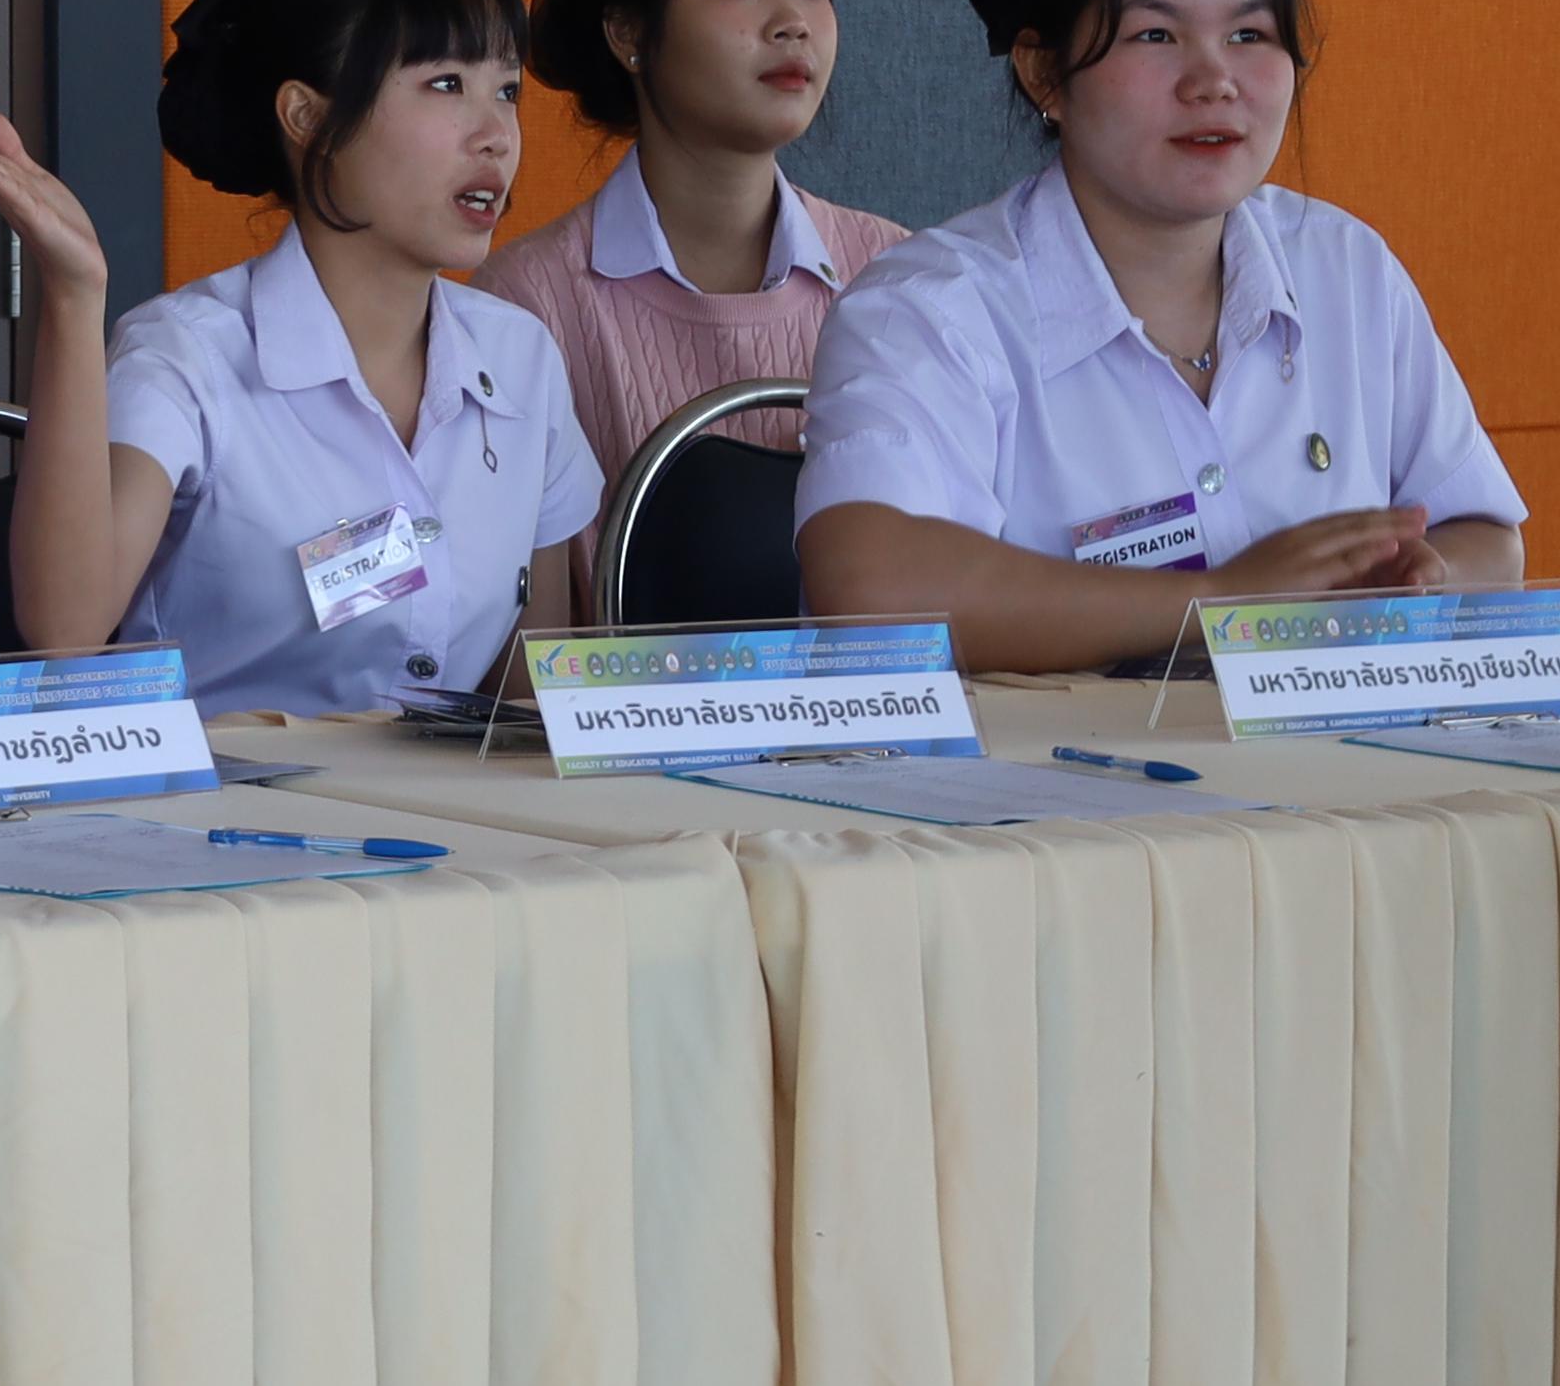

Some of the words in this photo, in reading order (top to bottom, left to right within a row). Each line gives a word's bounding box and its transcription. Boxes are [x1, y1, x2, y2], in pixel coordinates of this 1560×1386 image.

[574, 687, 942, 732] มหาวิทยาลัยราชภัฏอุตรดิตถ์
